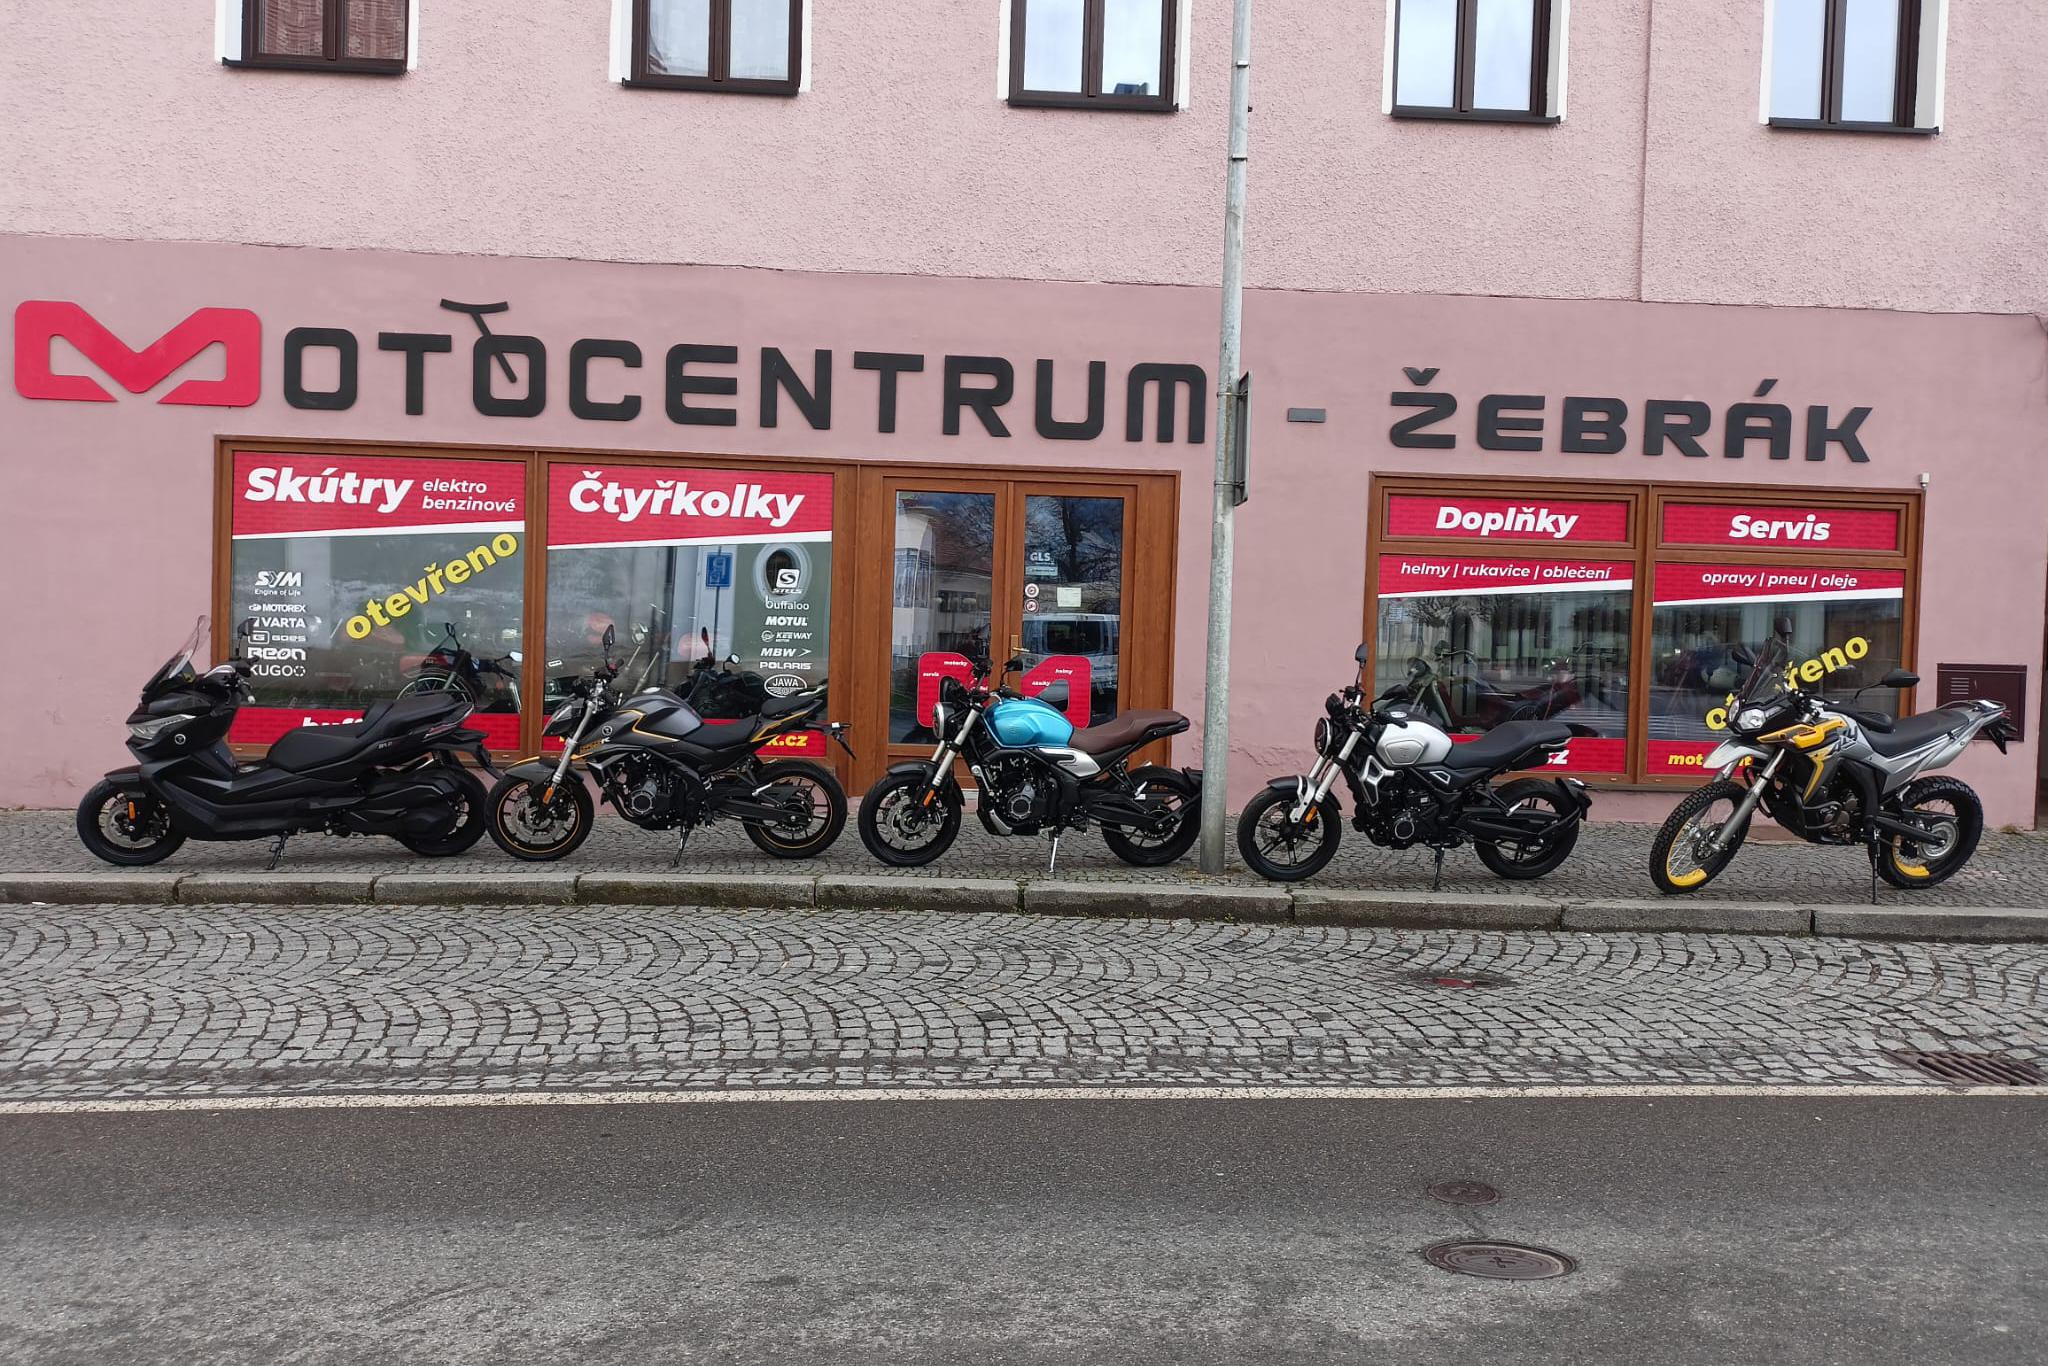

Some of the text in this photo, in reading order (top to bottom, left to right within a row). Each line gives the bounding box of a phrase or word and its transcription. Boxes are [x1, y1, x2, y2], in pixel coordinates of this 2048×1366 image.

[1389, 367, 1873, 463] ŽEBRÁK
[244, 466, 415, 514] Skútry
[422, 478, 487, 494] elektro
[421, 495, 516, 512] benzinové
[569, 470, 805, 527] Čtyřkolky
[1435, 506, 1579, 538] Doplňky
[1729, 514, 1830, 541] Servis
[1030, 552, 1050, 562] GLS
[1401, 562, 1450, 578] helmy
[1462, 563, 1531, 578] rukavice
[1543, 565, 1612, 579] oblečení
[255, 571, 302, 588] SYM
[345, 533, 518, 640] otevřeno
[1702, 572, 1757, 587] opravy
[1767, 573, 1808, 588] pneu
[1820, 574, 1858, 589] oleje
[263, 603, 306, 613] MOTOREX
[261, 617, 306, 628] VARTA
[765, 616, 808, 626] MOTUL
[776, 631, 812, 640] KEEWAY
[760, 648, 797, 657] MBW
[760, 661, 814, 670] POLARIS
[772, 677, 799, 687] JAWA
